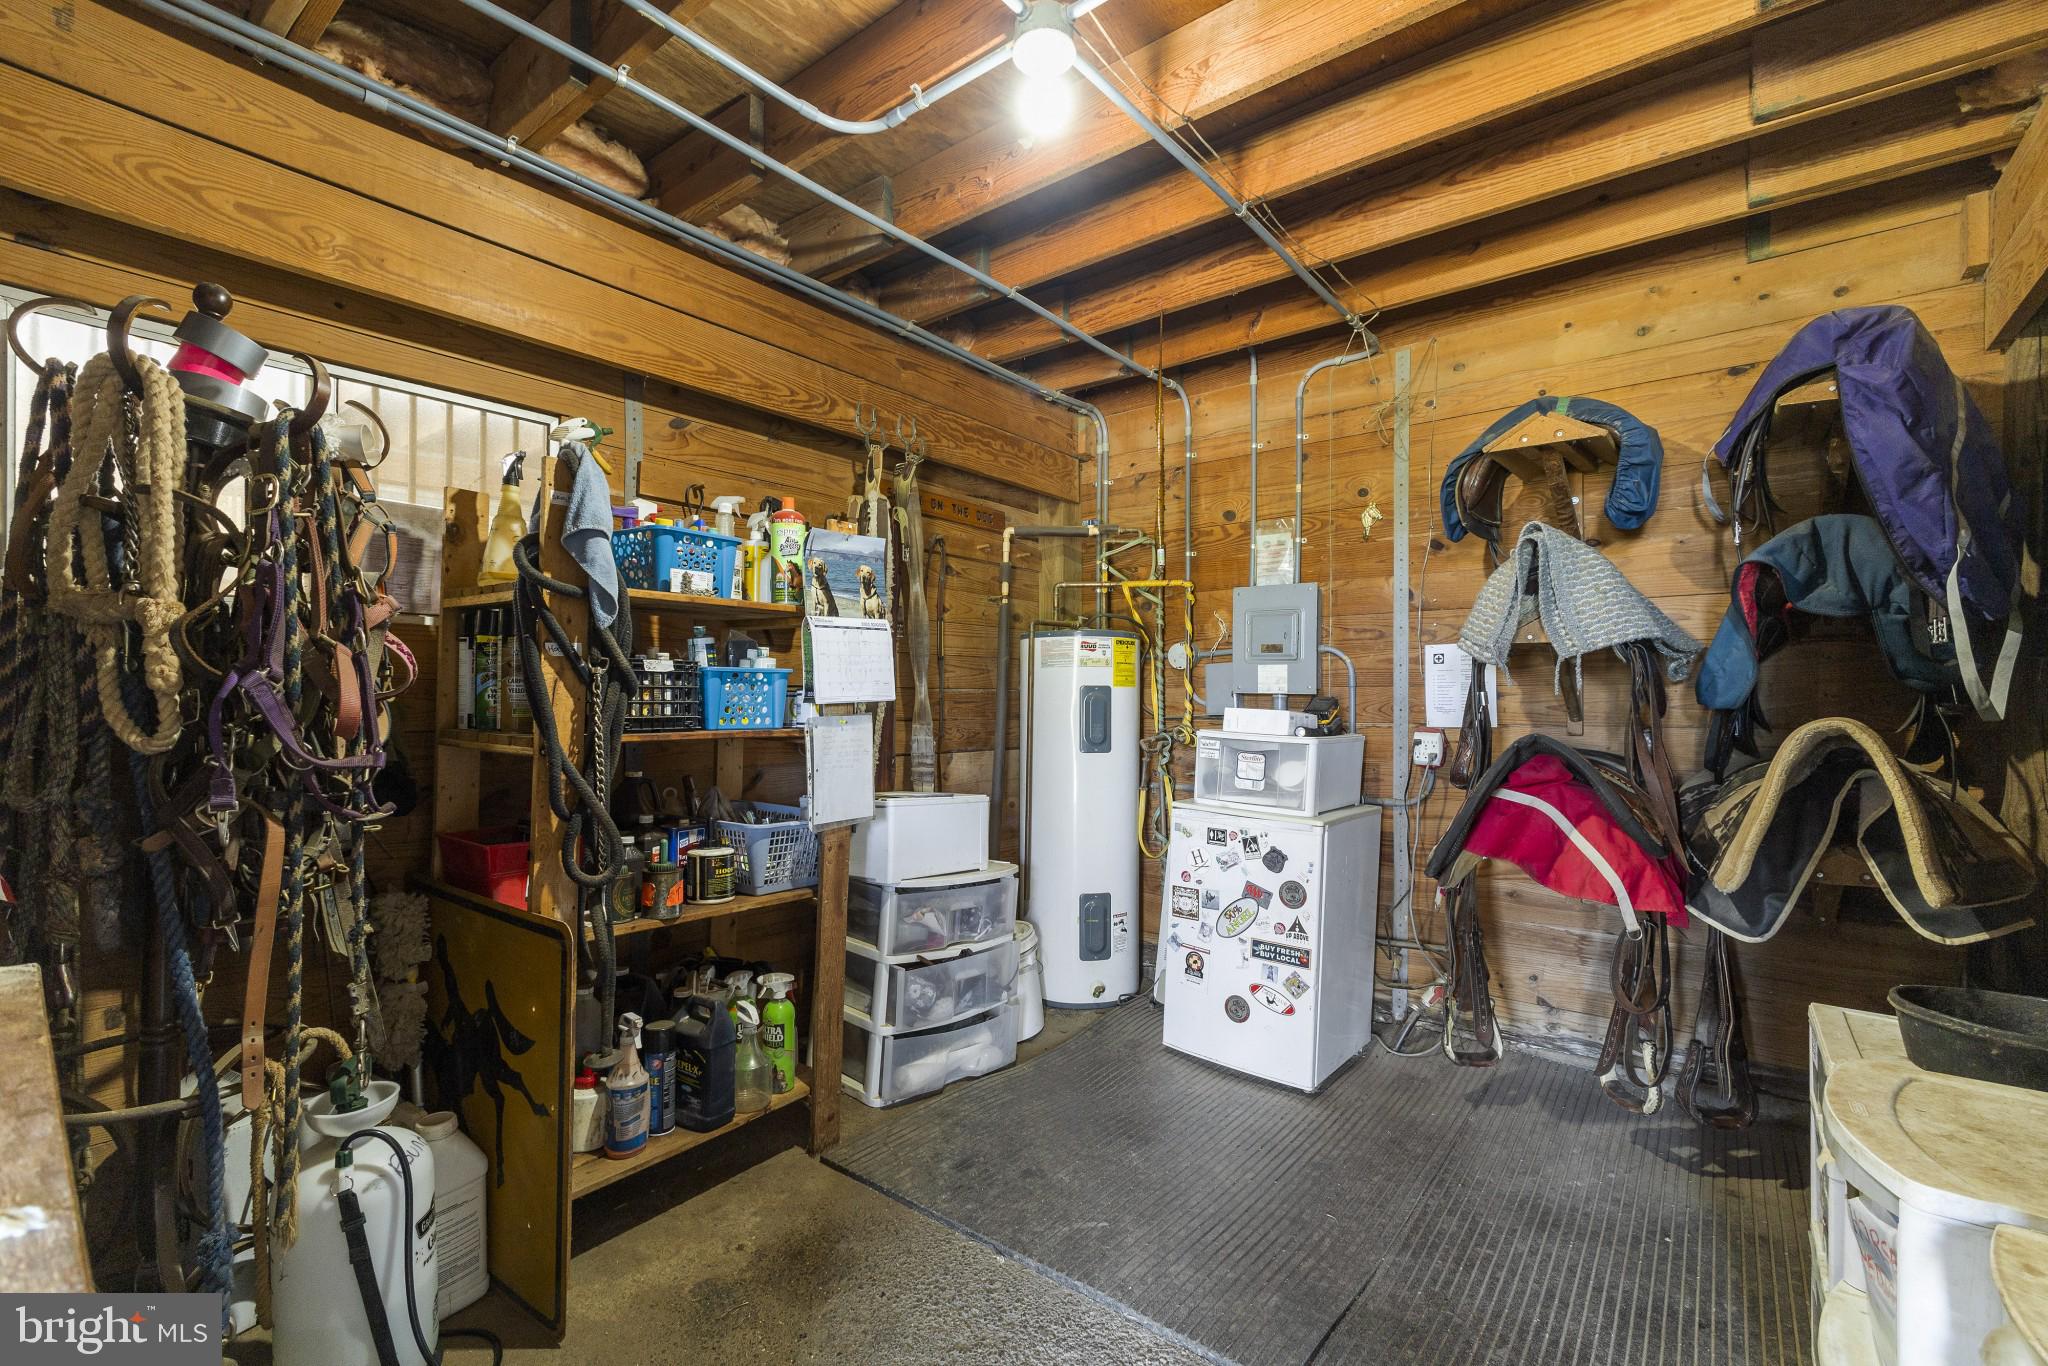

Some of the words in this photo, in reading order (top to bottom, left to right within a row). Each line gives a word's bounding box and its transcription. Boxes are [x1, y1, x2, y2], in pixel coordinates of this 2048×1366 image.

[952, 503, 969, 518] THE
[1259, 943, 1276, 953] BUY
[1276, 946, 1301, 957] FRESH
[1259, 951, 1275, 960] BUY
[1276, 954, 1301, 965] LOCAL
